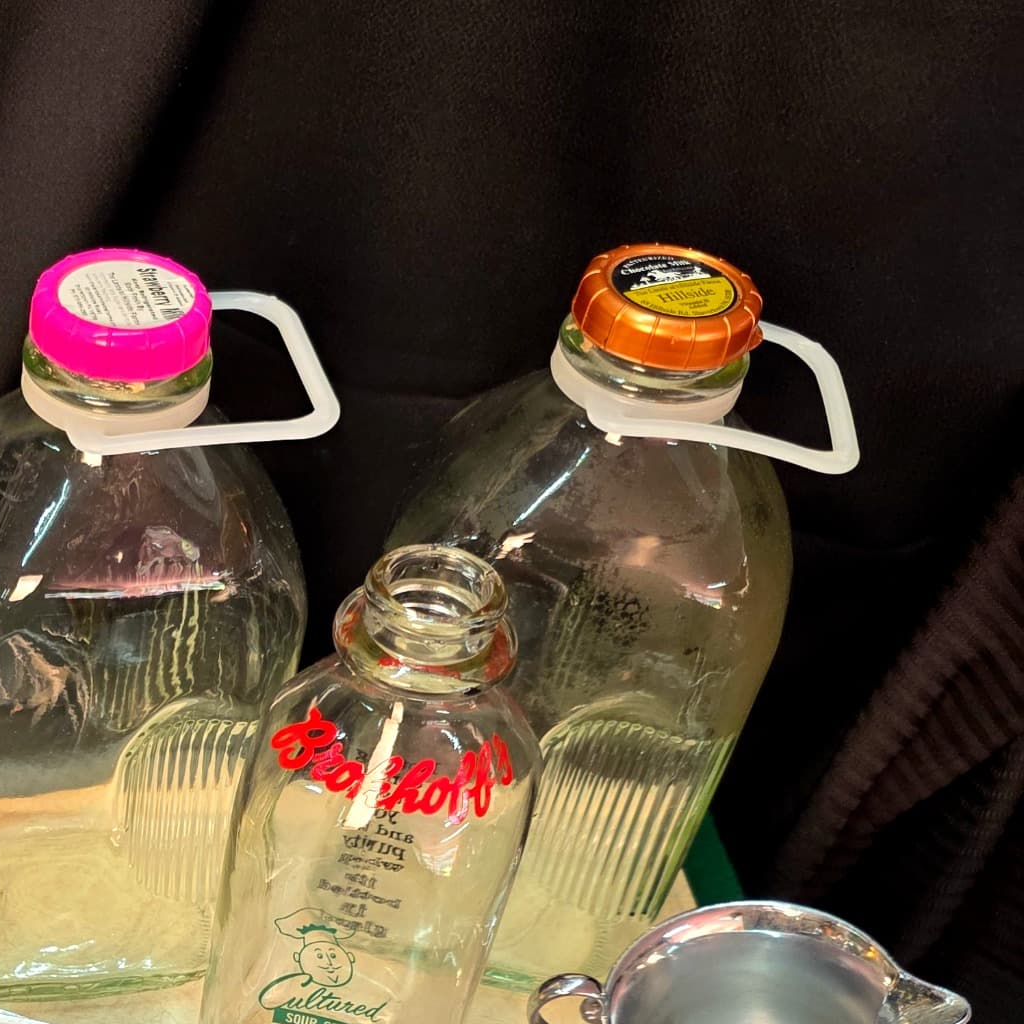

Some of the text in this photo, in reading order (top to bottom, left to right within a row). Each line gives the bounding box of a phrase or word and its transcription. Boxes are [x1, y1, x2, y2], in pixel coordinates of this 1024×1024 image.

[620, 263, 668, 276] Chocolate
[667, 259, 692, 267] Milk
[136, 267, 172, 306] Strawberry
[658, 287, 716, 304] Hillside
[258, 972, 388, 1022] Cultured
